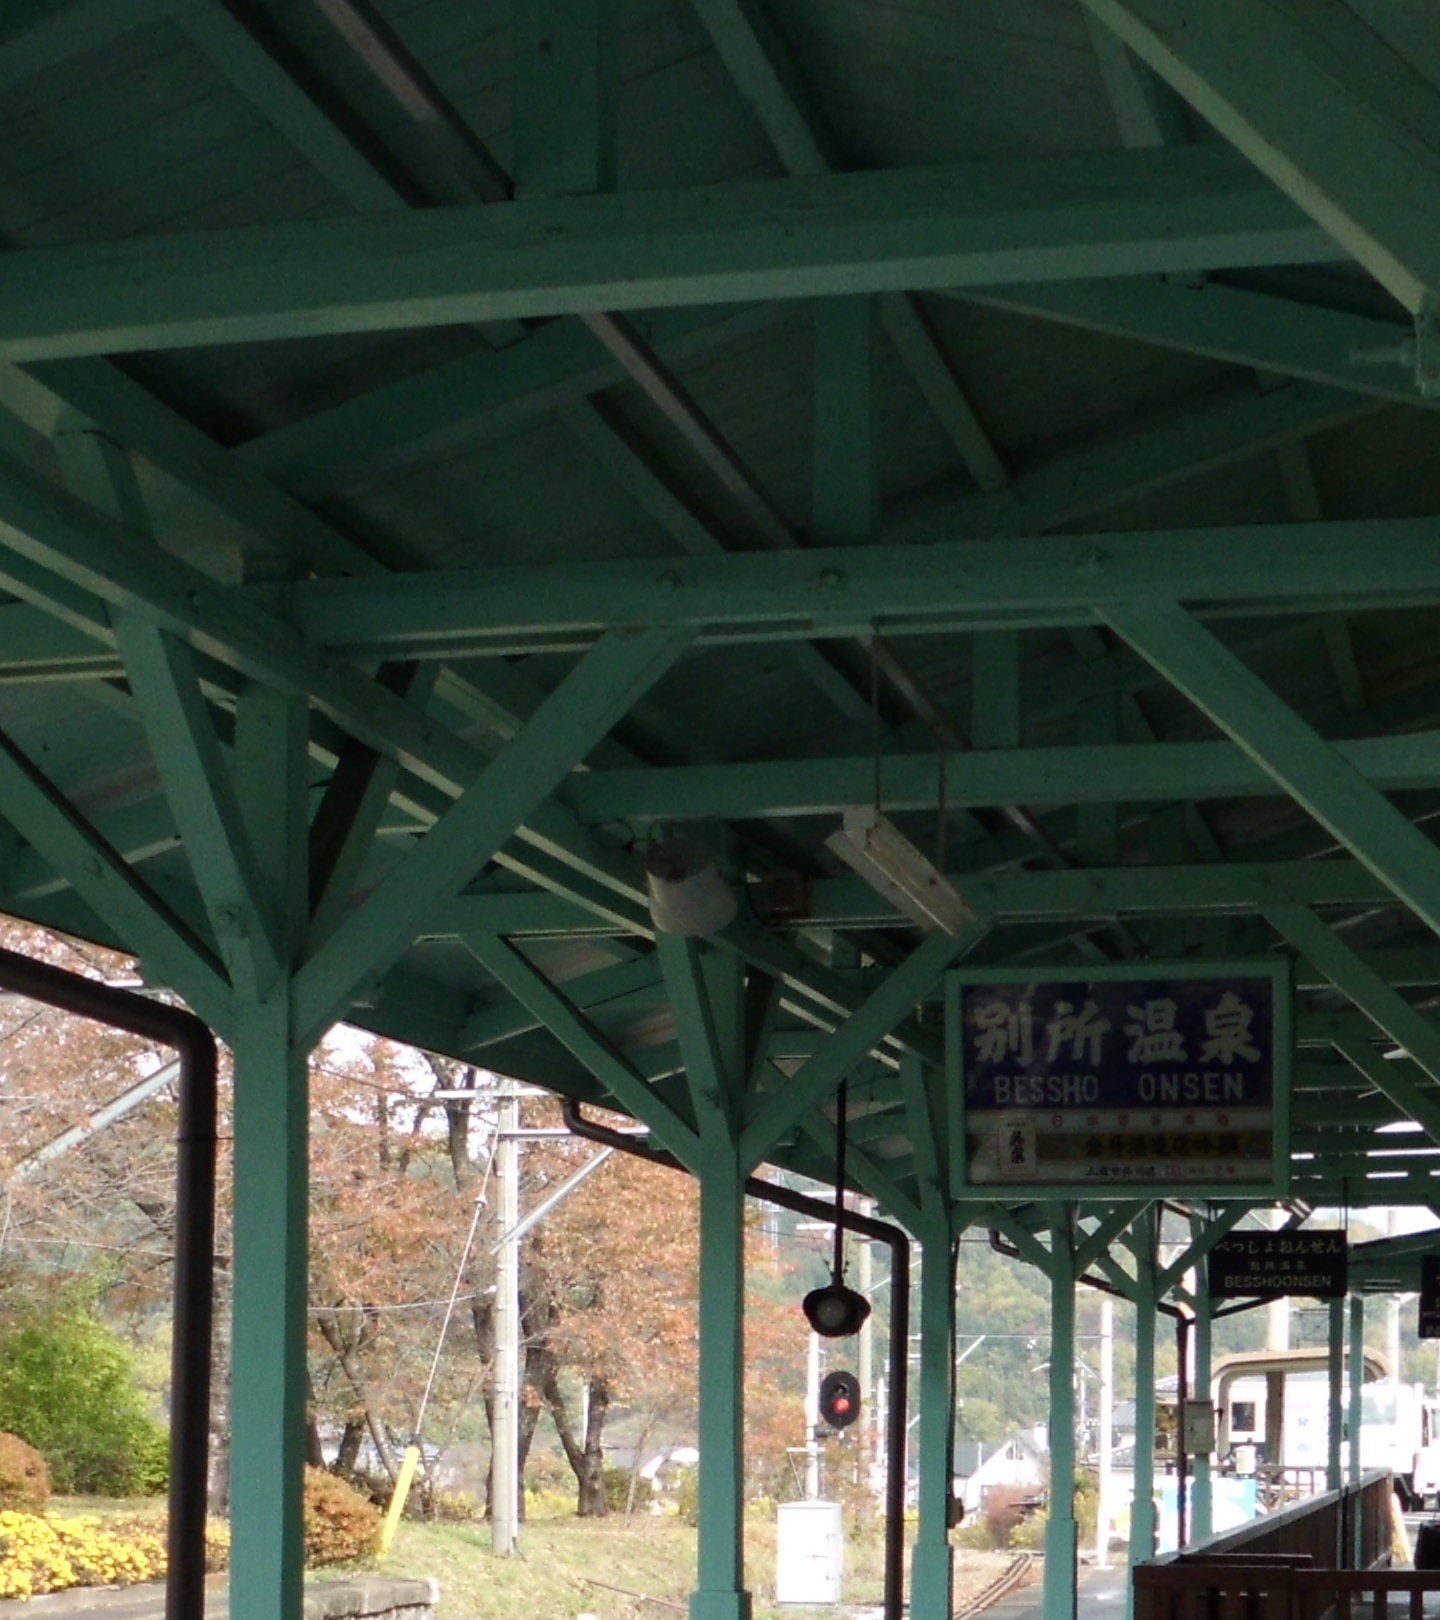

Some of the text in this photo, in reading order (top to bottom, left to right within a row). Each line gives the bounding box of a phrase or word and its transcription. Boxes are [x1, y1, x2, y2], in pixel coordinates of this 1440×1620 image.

[972, 991, 1262, 1066] 別所温泉
[994, 1072, 1245, 1106] BESSHO ONSEN
[1224, 1275, 1332, 1289] BESSHOONSEN
